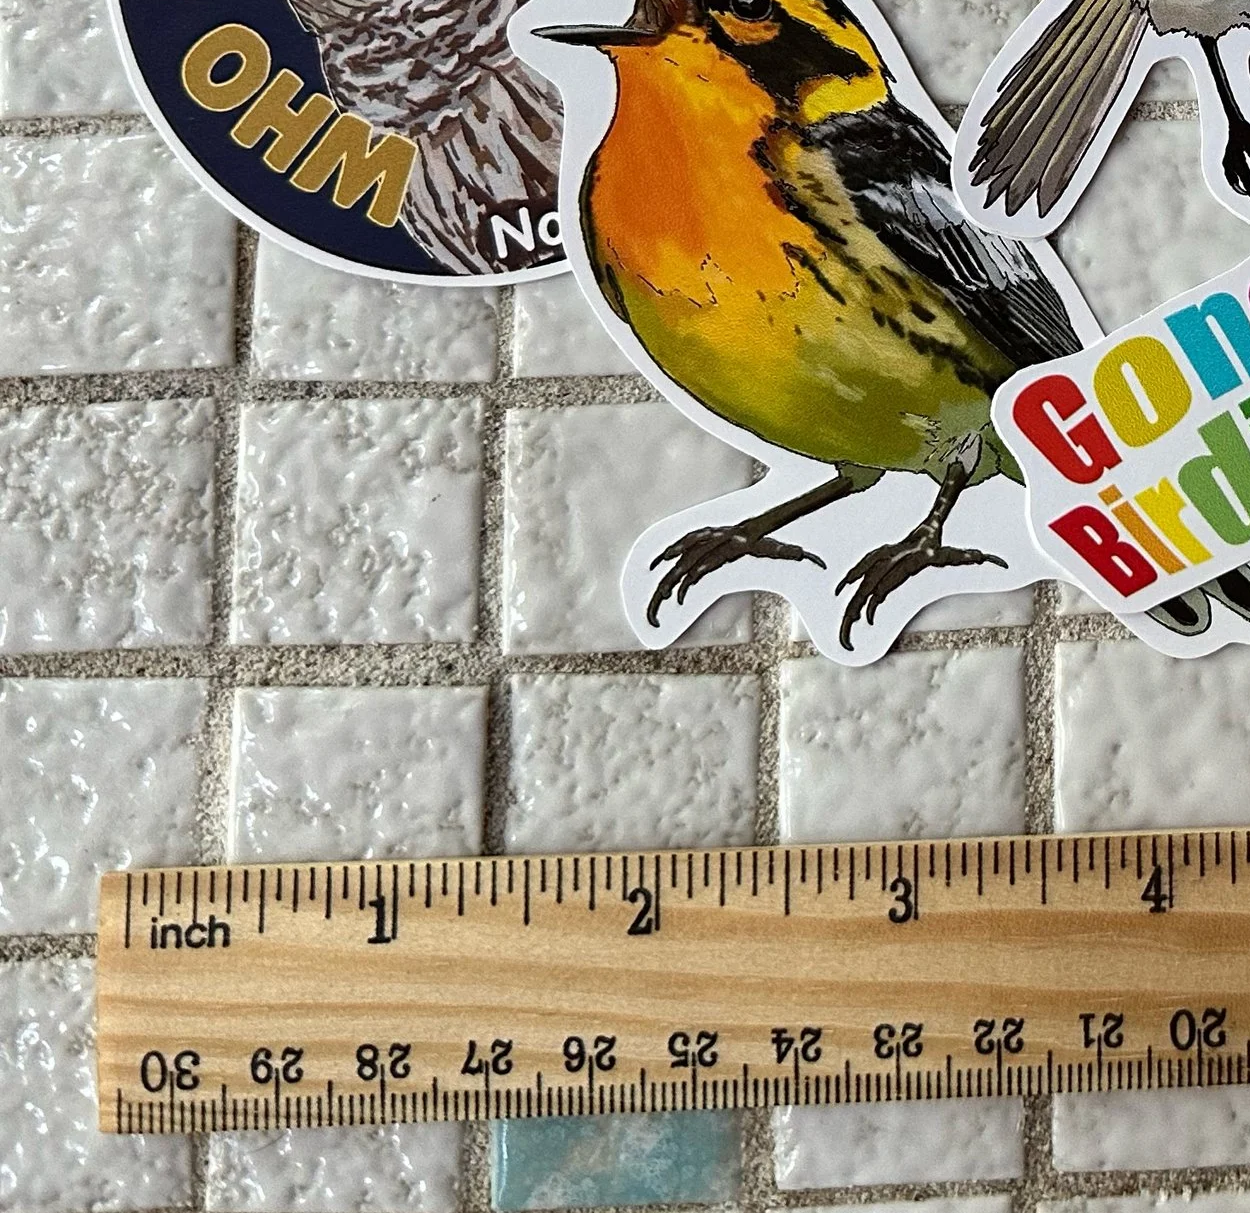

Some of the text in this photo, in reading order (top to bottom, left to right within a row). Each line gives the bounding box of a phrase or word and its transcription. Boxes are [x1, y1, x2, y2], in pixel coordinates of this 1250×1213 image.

[182, 23, 417, 227] WHO
[150, 917, 231, 949] inch
[367, 896, 392, 944] 1
[627, 888, 653, 935] 2
[888, 877, 914, 923] 3
[1140, 865, 1167, 914] 4
[771, 1027, 822, 1063] 24
[873, 1022, 924, 1058] 23
[974, 1017, 1024, 1054] 22
[1079, 1012, 1125, 1049] 21
[1169, 1008, 1227, 1050] 20
[250, 1048, 304, 1084] 29
[356, 1043, 411, 1081] 28
[461, 1039, 513, 1076] 27
[562, 1036, 617, 1072] 26
[668, 1031, 718, 1069] 25
[140, 1050, 200, 1093] 30
